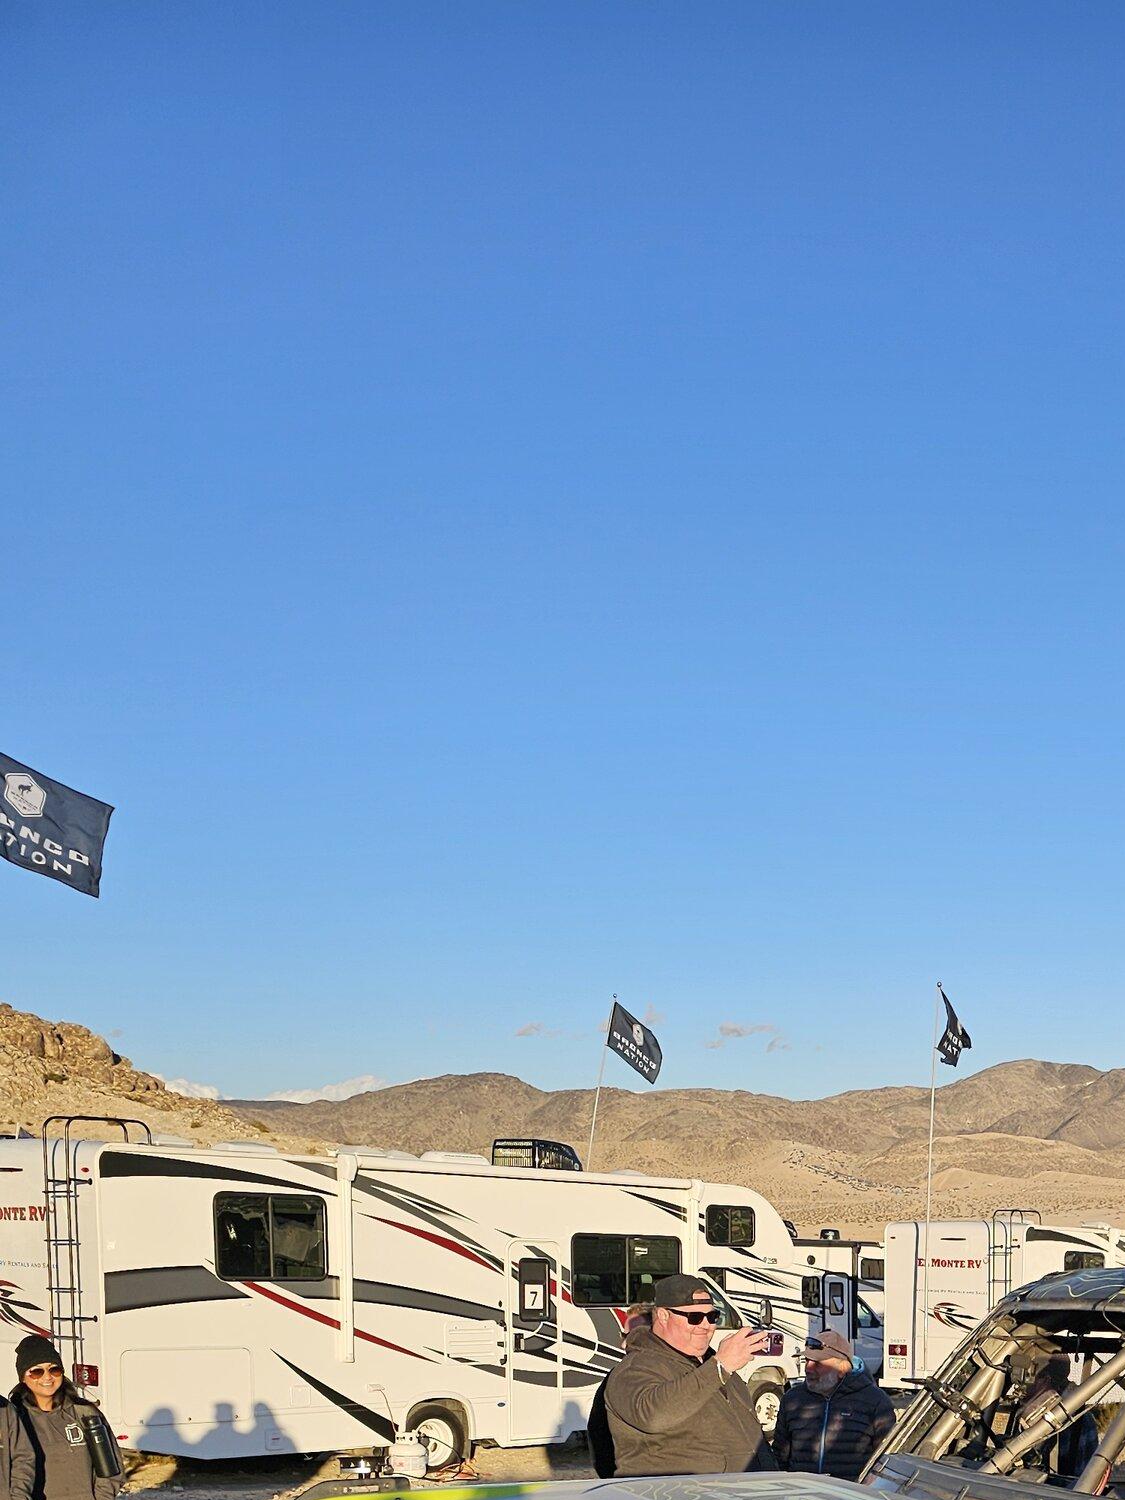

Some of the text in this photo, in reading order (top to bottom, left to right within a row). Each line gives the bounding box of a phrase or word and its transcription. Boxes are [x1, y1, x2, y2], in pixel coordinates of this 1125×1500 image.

[613, 1031, 657, 1070] BRONCO
[617, 1042, 649, 1073] NATION
[931, 1258, 966, 1268] MONTE
[967, 1258, 982, 1269] RV
[529, 1291, 538, 1307] 7
